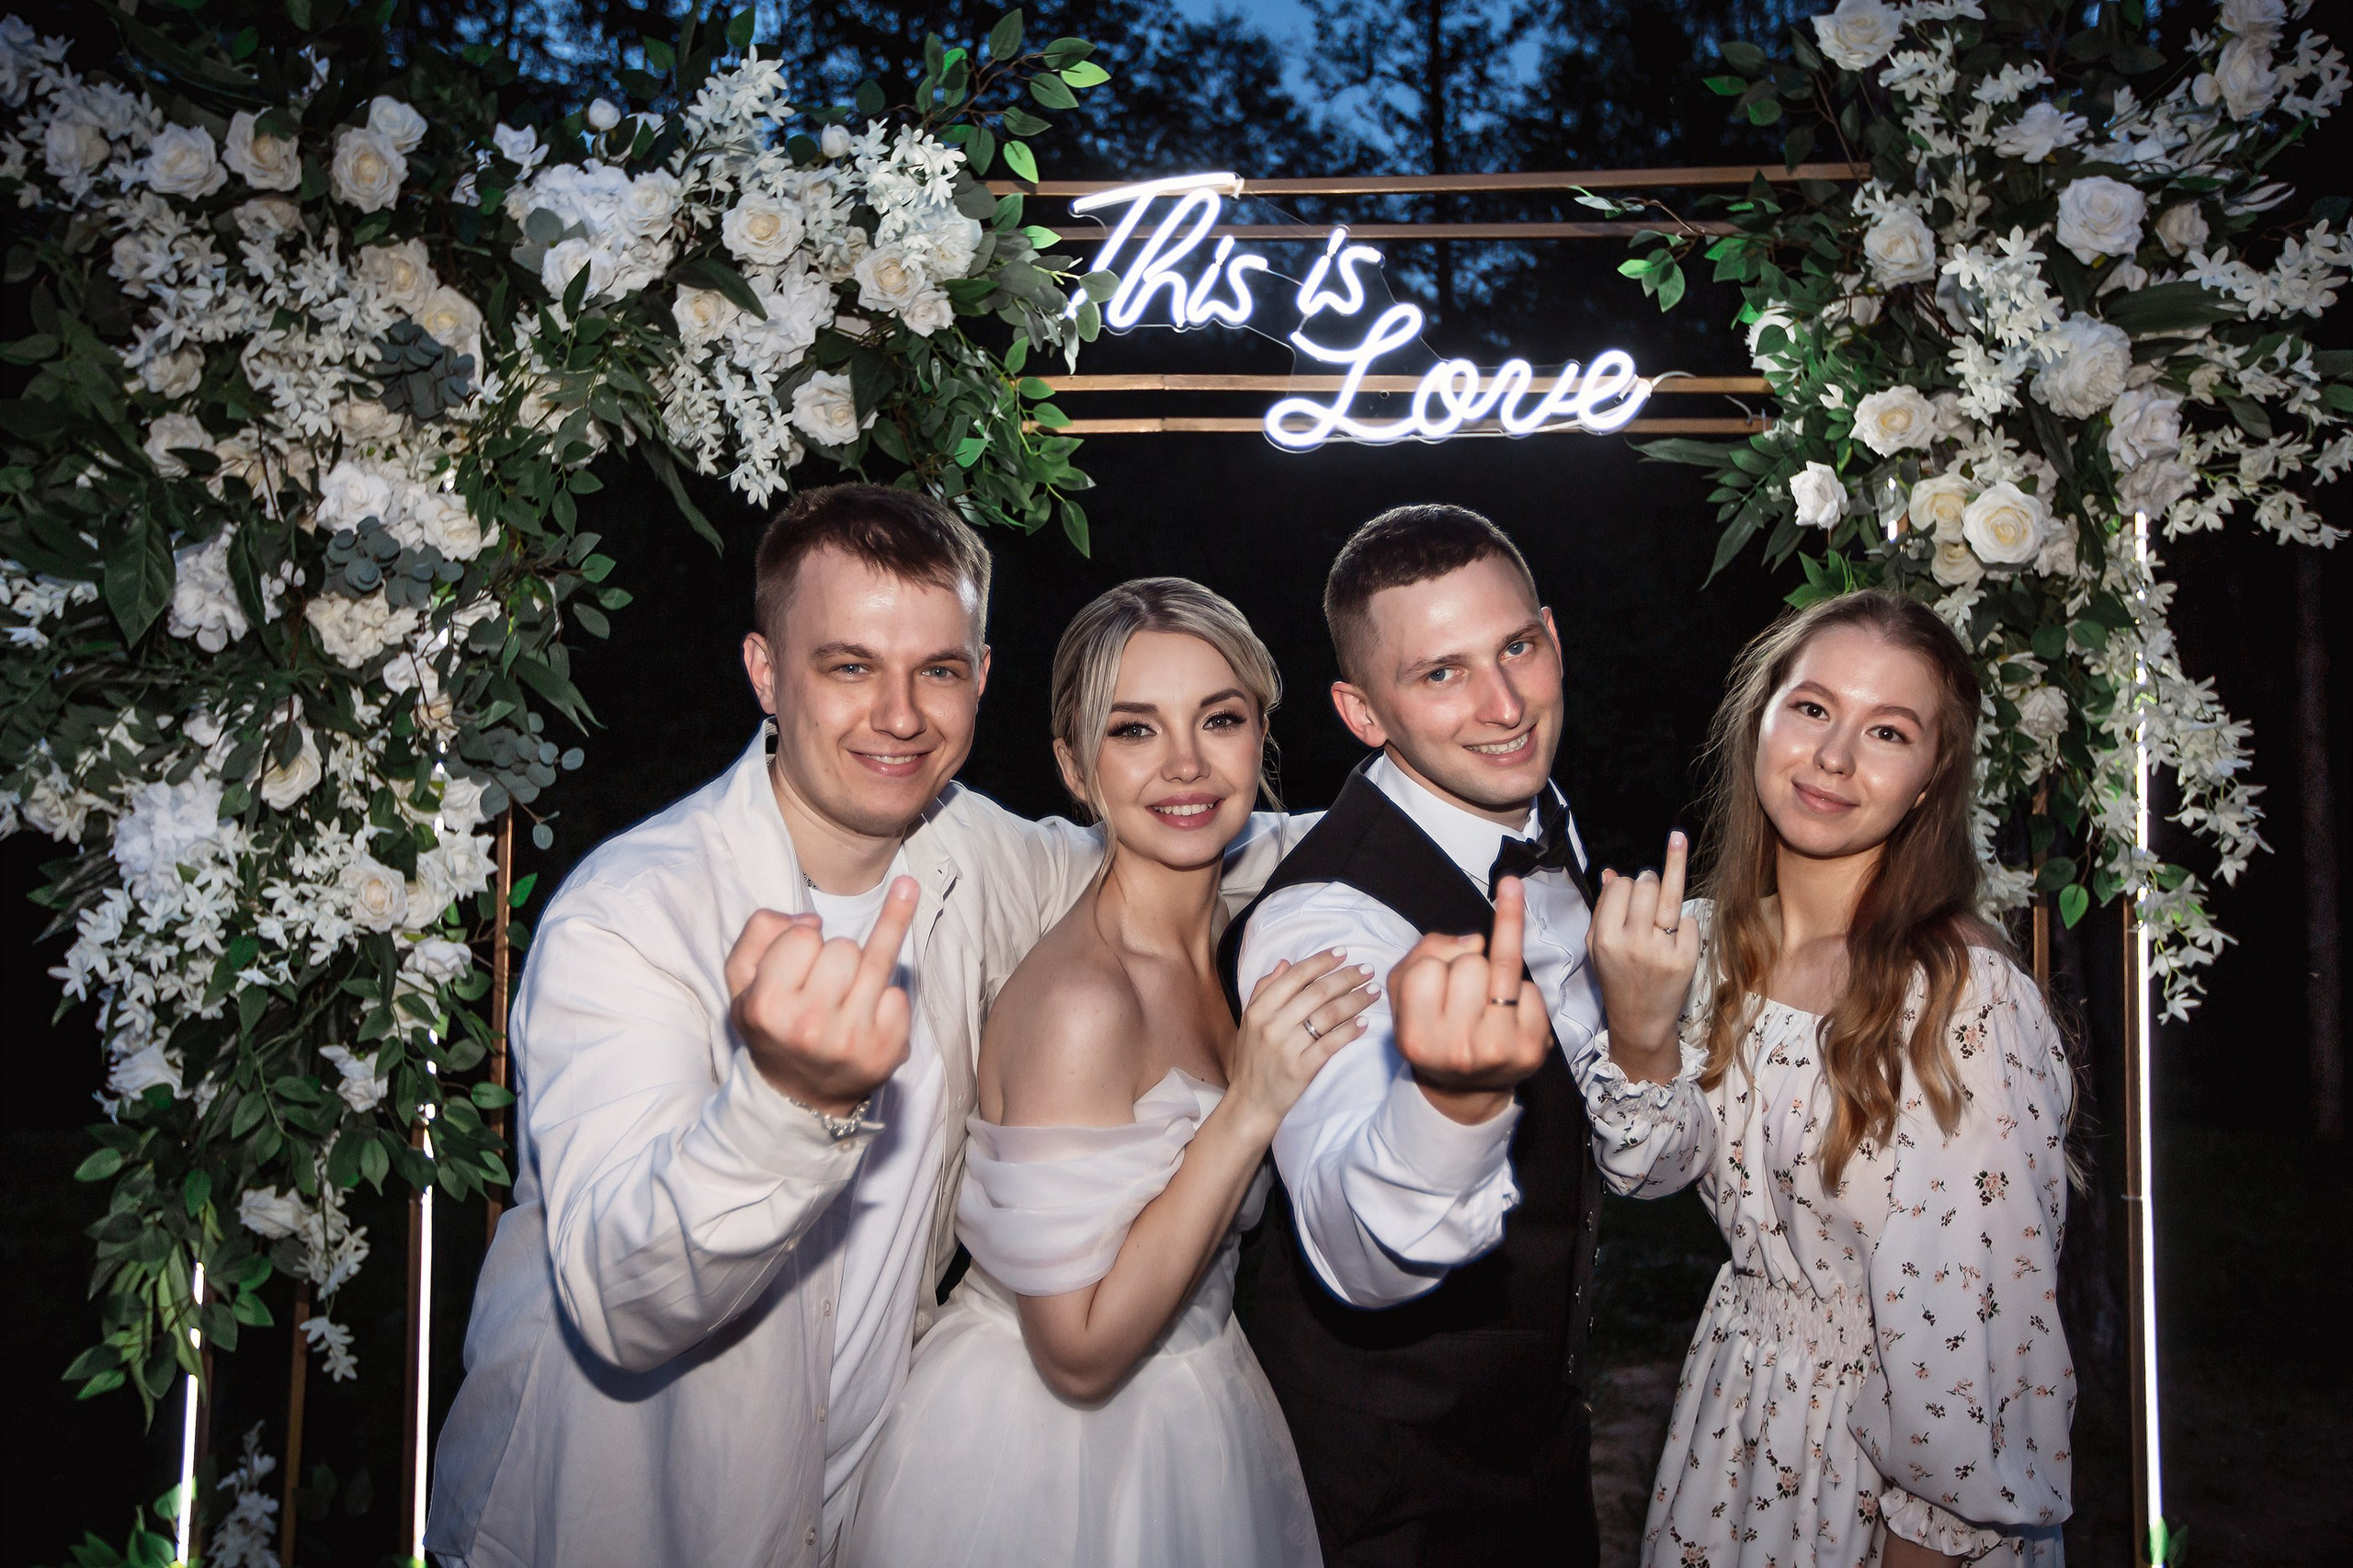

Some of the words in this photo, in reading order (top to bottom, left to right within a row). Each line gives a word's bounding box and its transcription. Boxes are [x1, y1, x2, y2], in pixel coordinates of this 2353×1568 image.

[1067, 172, 1268, 328] This
[1297, 226, 1381, 315] is
[1264, 302, 1651, 448] Love
